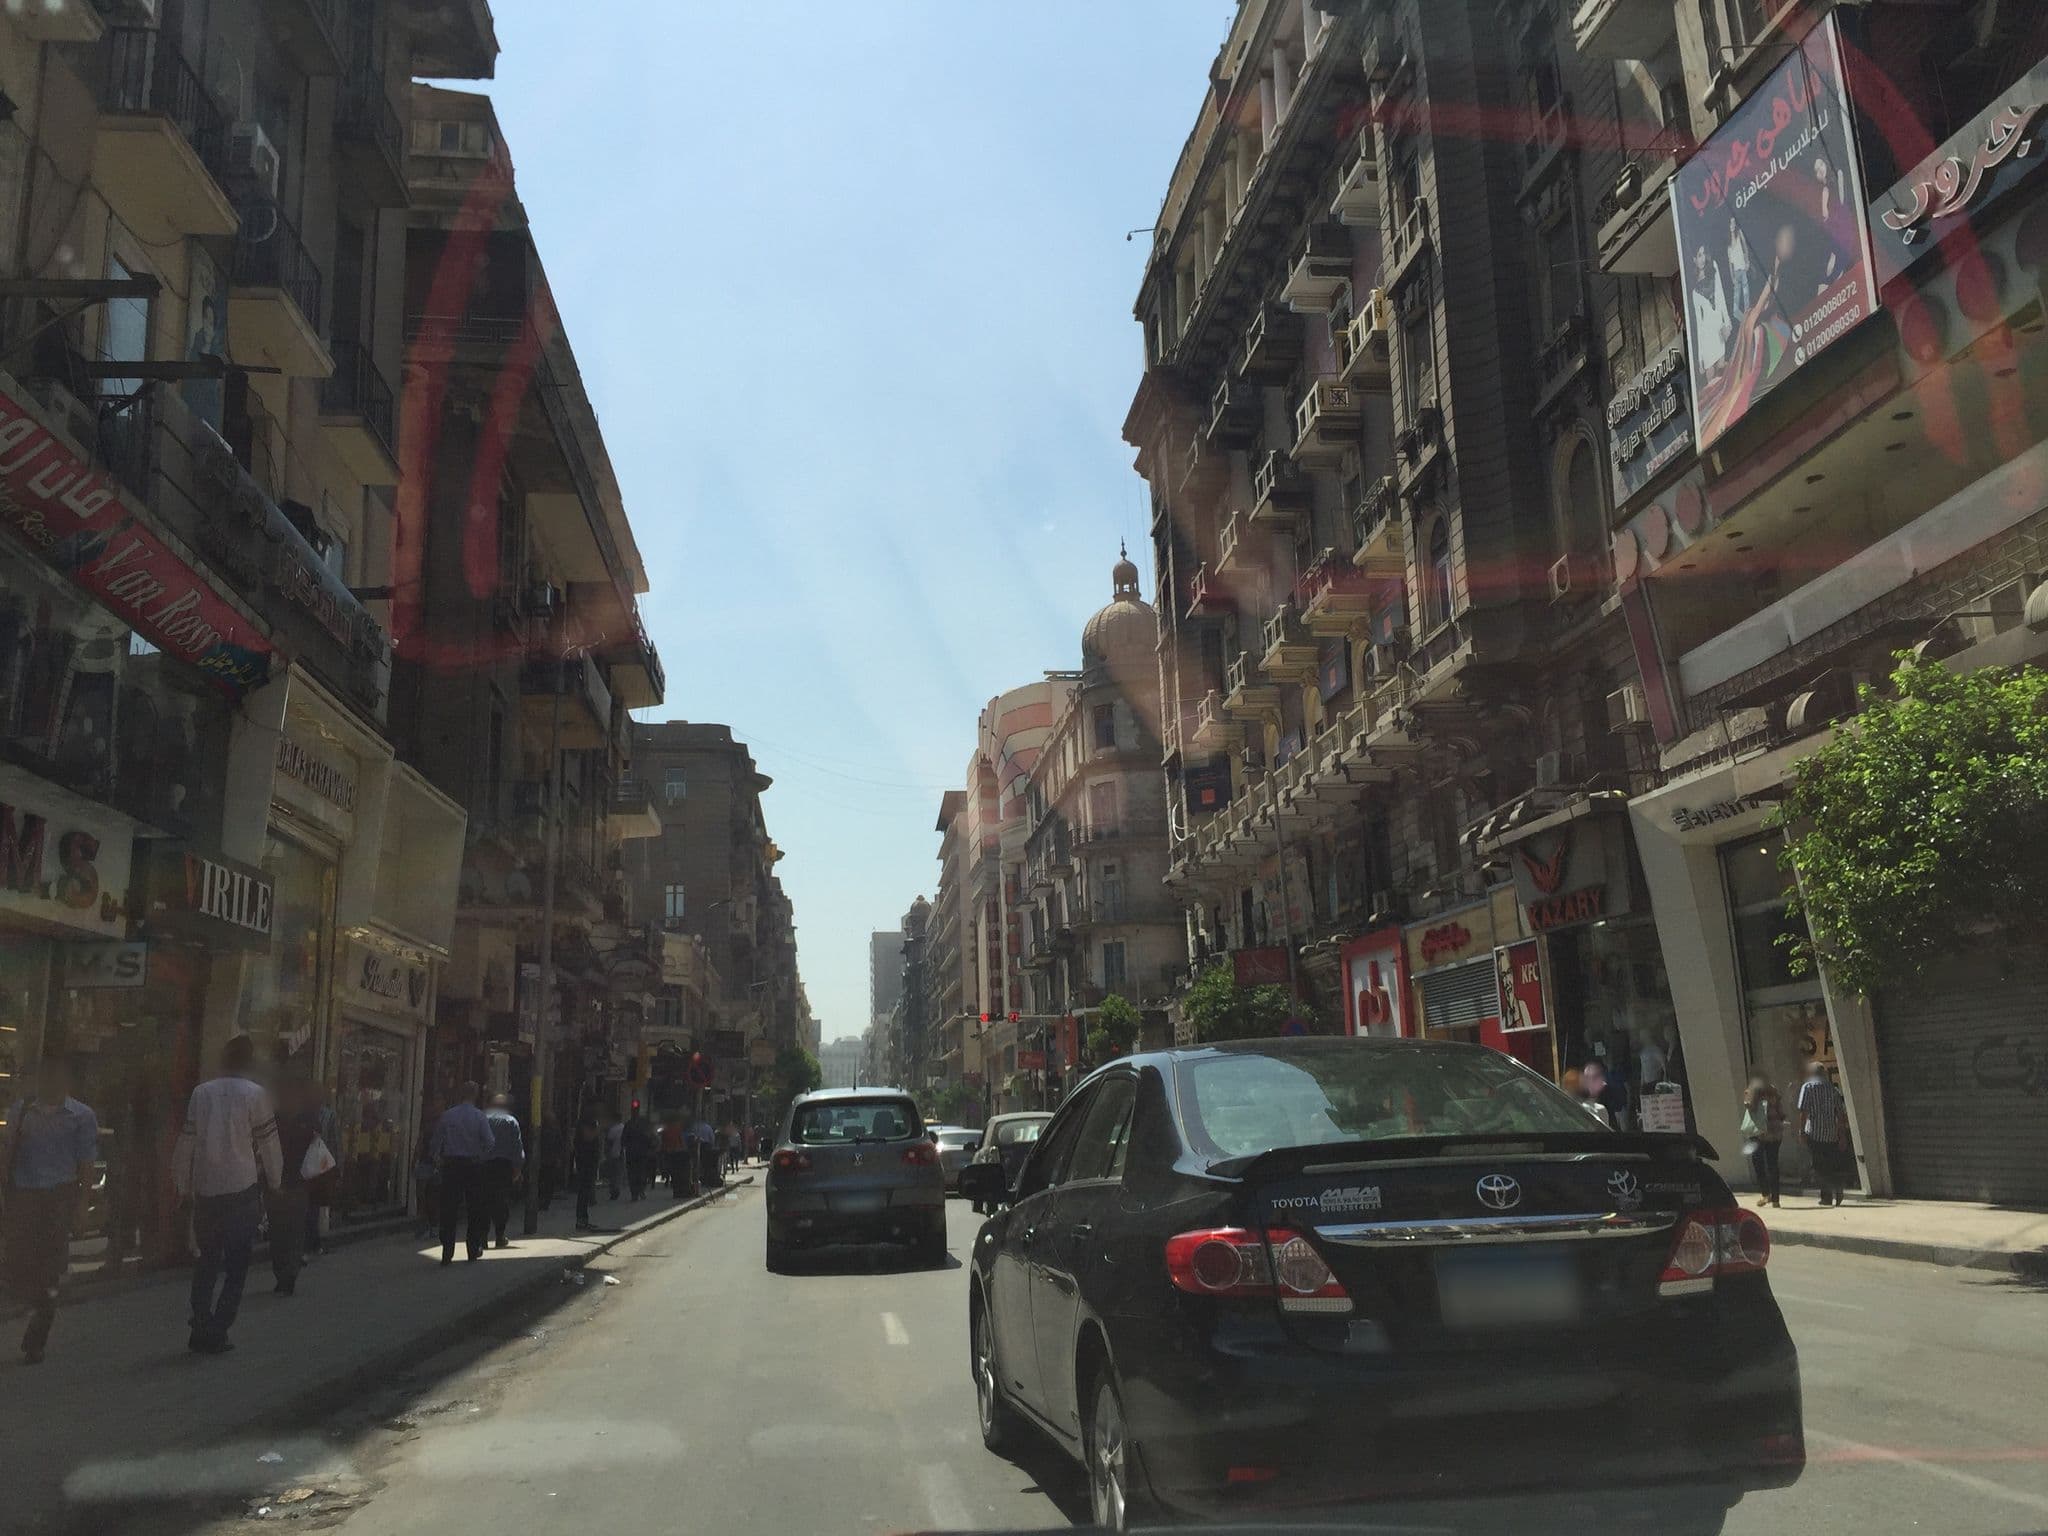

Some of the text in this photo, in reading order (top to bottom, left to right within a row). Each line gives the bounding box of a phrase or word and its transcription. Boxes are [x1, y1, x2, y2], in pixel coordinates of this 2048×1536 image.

[184, 851, 272, 934] VIRILE
[1521, 960, 1539, 985] KFC
[1271, 1196, 1319, 1209] TOYOTA
